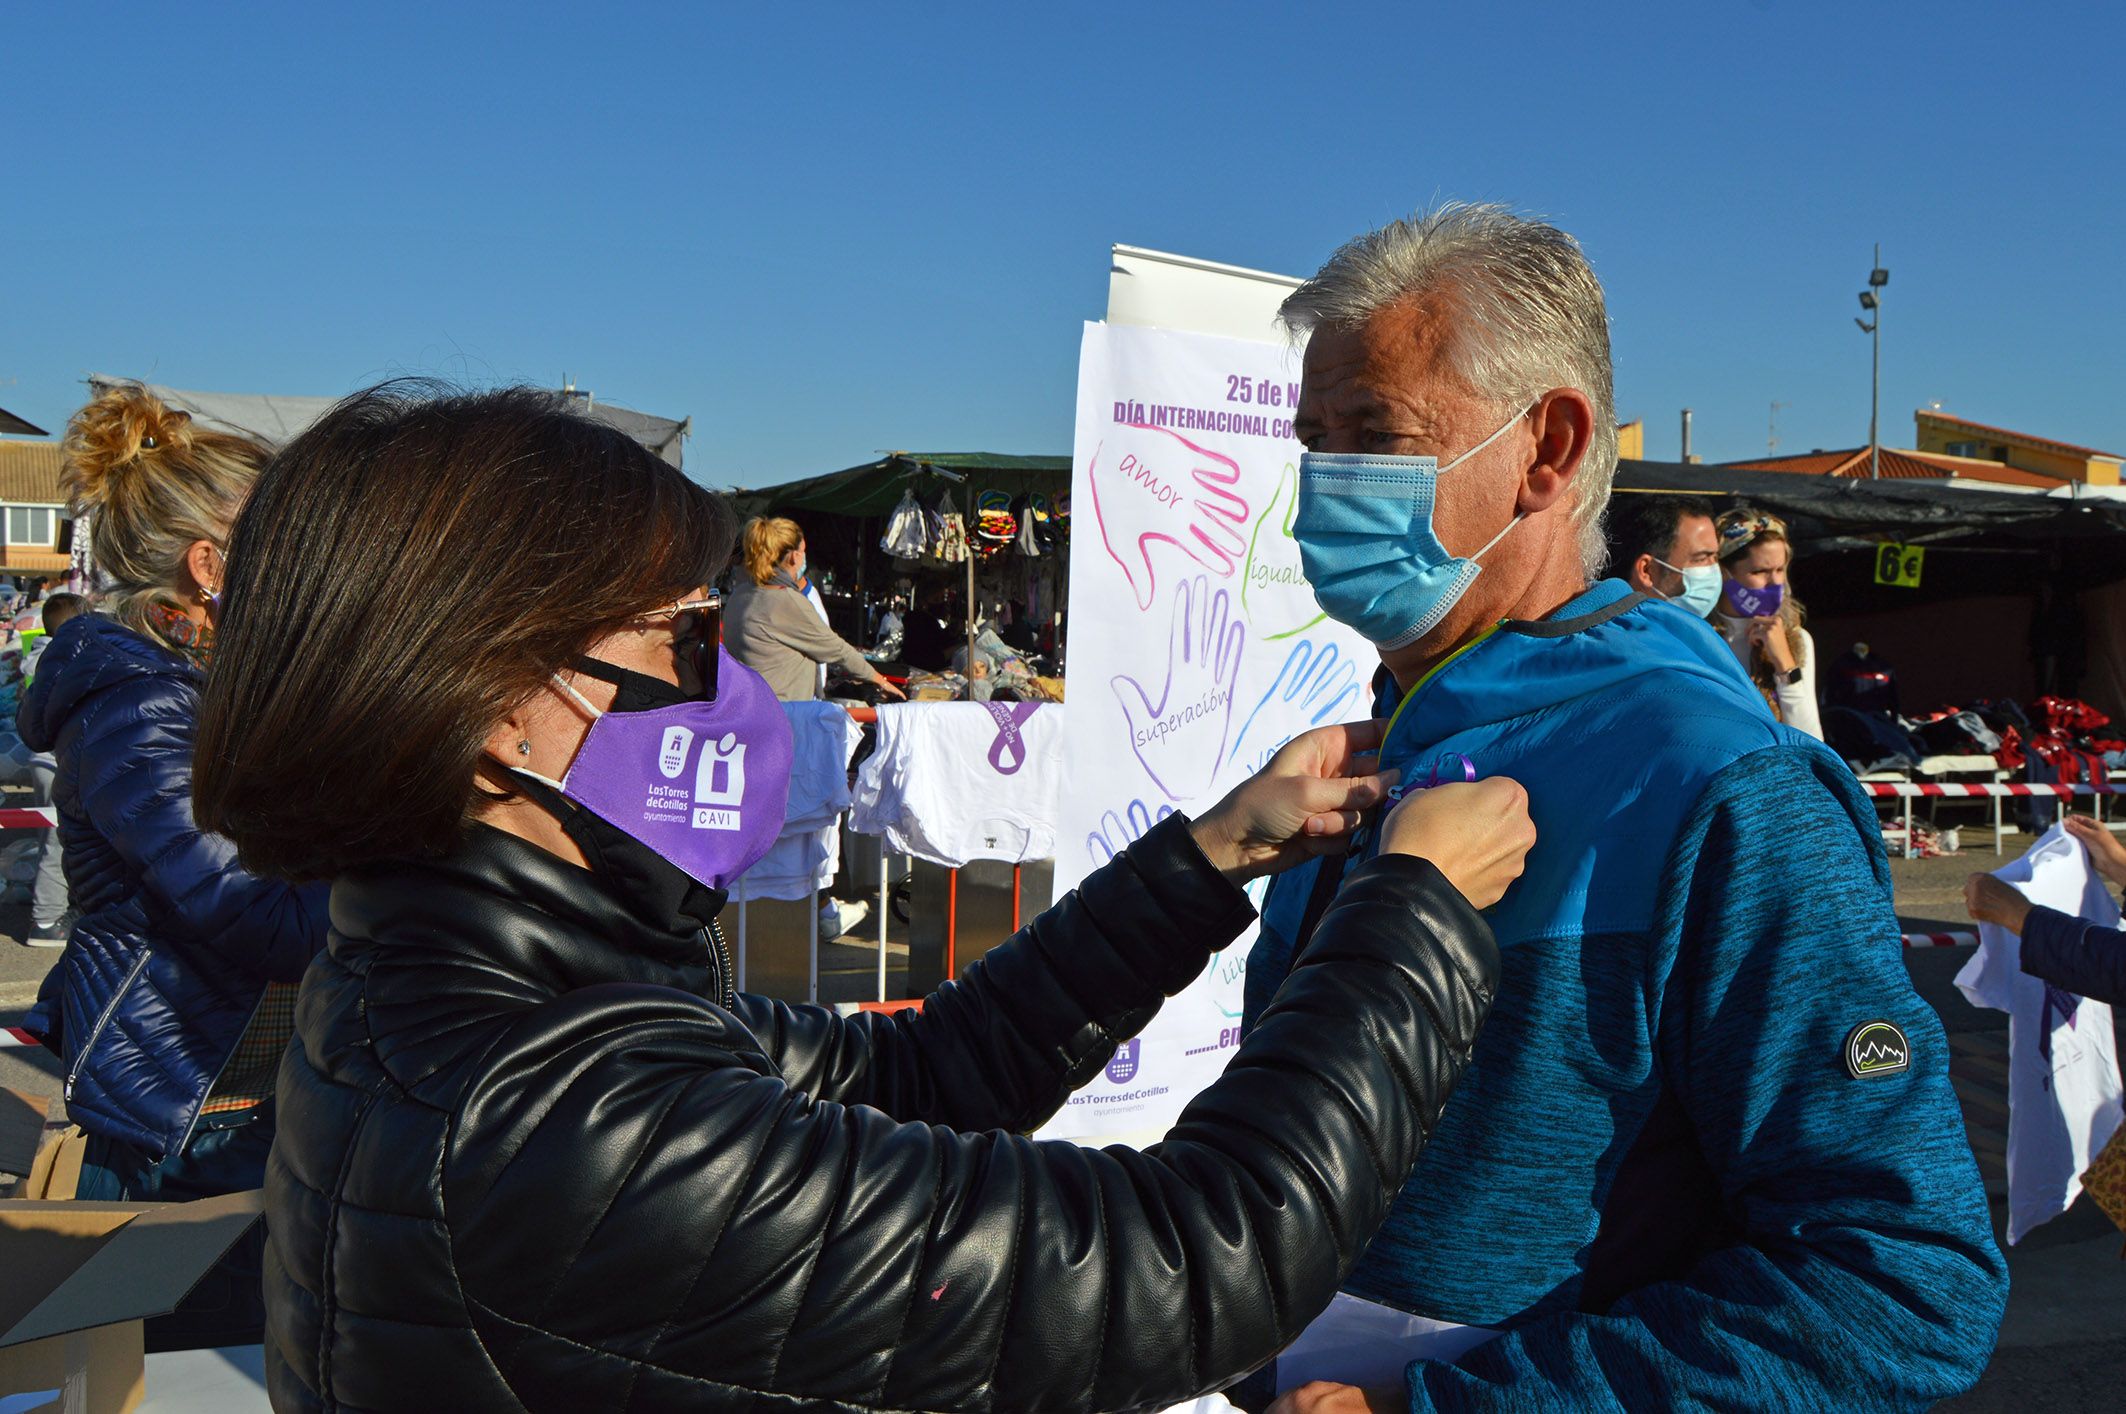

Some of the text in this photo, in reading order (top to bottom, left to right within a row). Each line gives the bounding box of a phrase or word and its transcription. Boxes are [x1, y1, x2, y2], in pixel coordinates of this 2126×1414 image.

[1226, 374, 1252, 403] 25
[1257, 379, 1282, 407] de
[1113, 399, 1296, 440] DÍA INTERNACIONAL CO
[1119, 453, 1183, 509] amor
[1137, 688, 1229, 747] superación
[648, 783, 689, 799] LasTorres
[646, 796, 688, 811] deCotillas
[643, 811, 686, 824] ayuntamiento
[699, 810, 730, 825] CAVI
[1094, 1104, 1145, 1117] ayuntamiento
